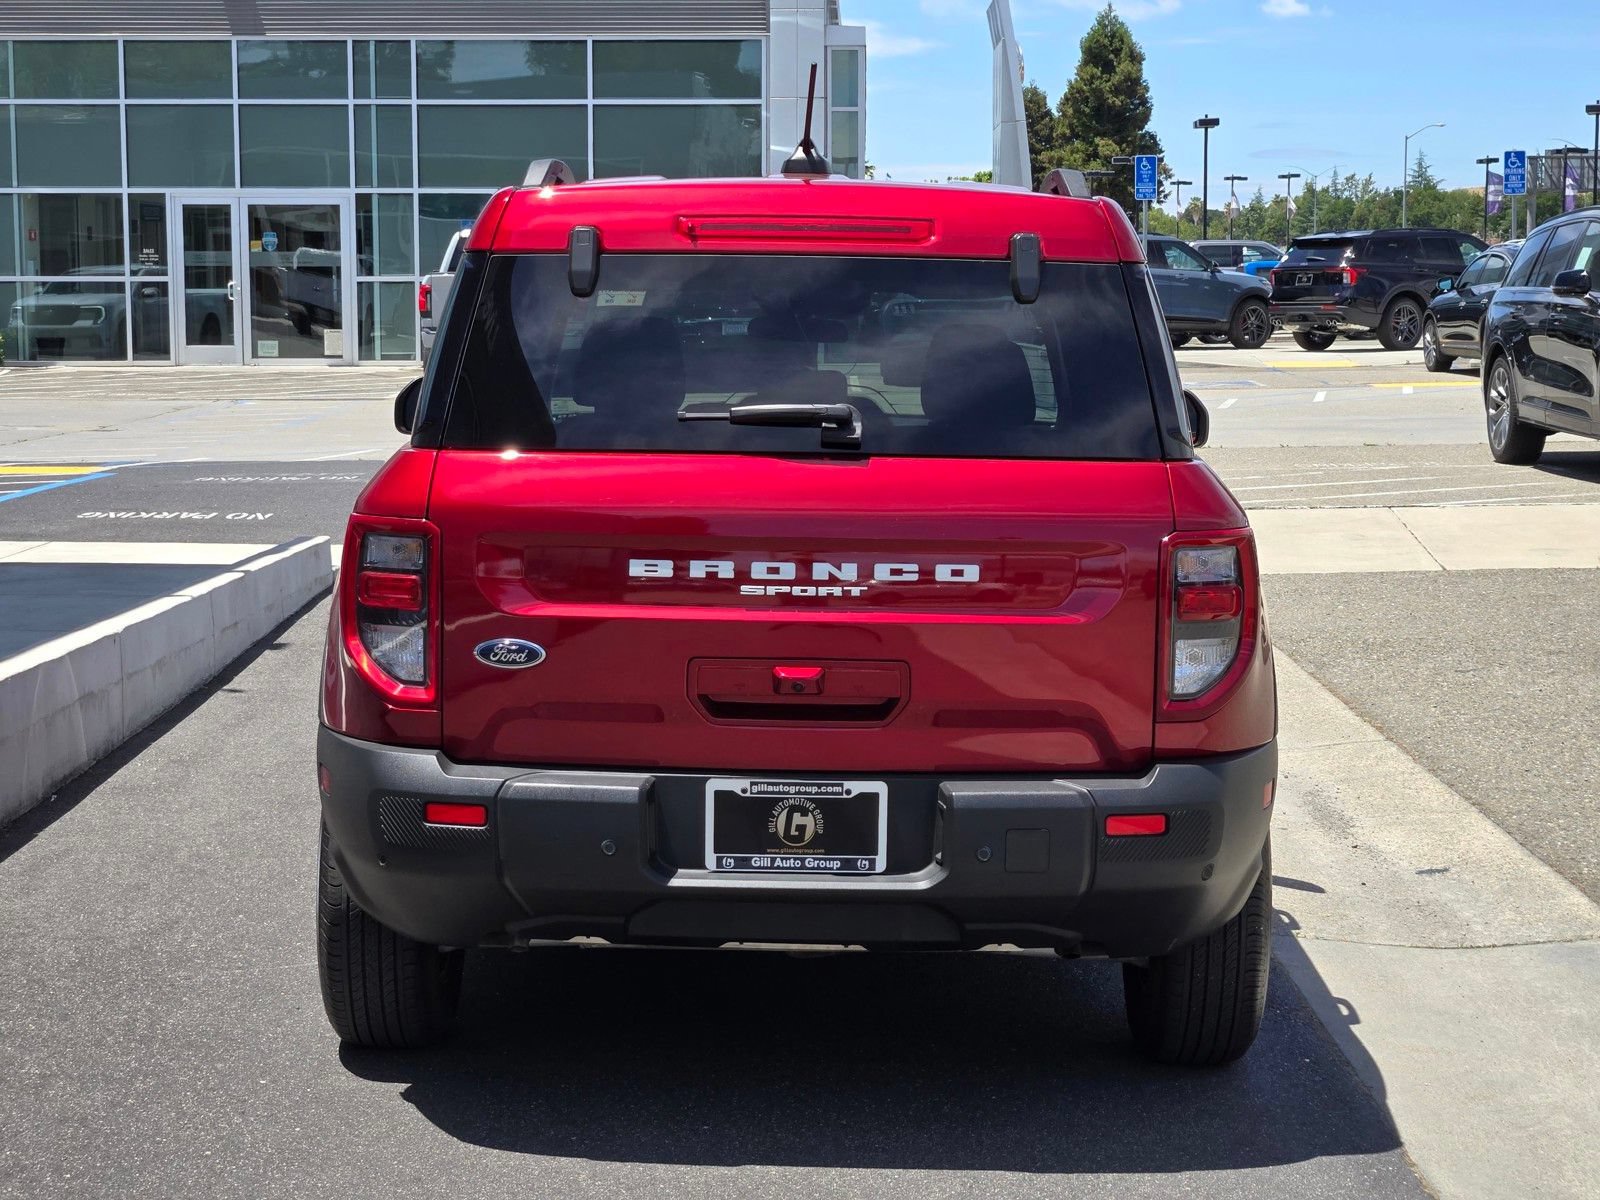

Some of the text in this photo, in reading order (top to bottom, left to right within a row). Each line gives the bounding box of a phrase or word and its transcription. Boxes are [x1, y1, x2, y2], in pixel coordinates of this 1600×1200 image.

[77, 511, 274, 520] NO PARKING
[628, 558, 981, 582] BRONCO
[740, 585, 868, 596] SPORT
[490, 643, 528, 662] Ford
[751, 782, 842, 794] gillautogroup.com
[768, 798, 825, 834] GILL AUTOMOTIVE GROUP
[751, 857, 841, 870] Gill Auto Group
